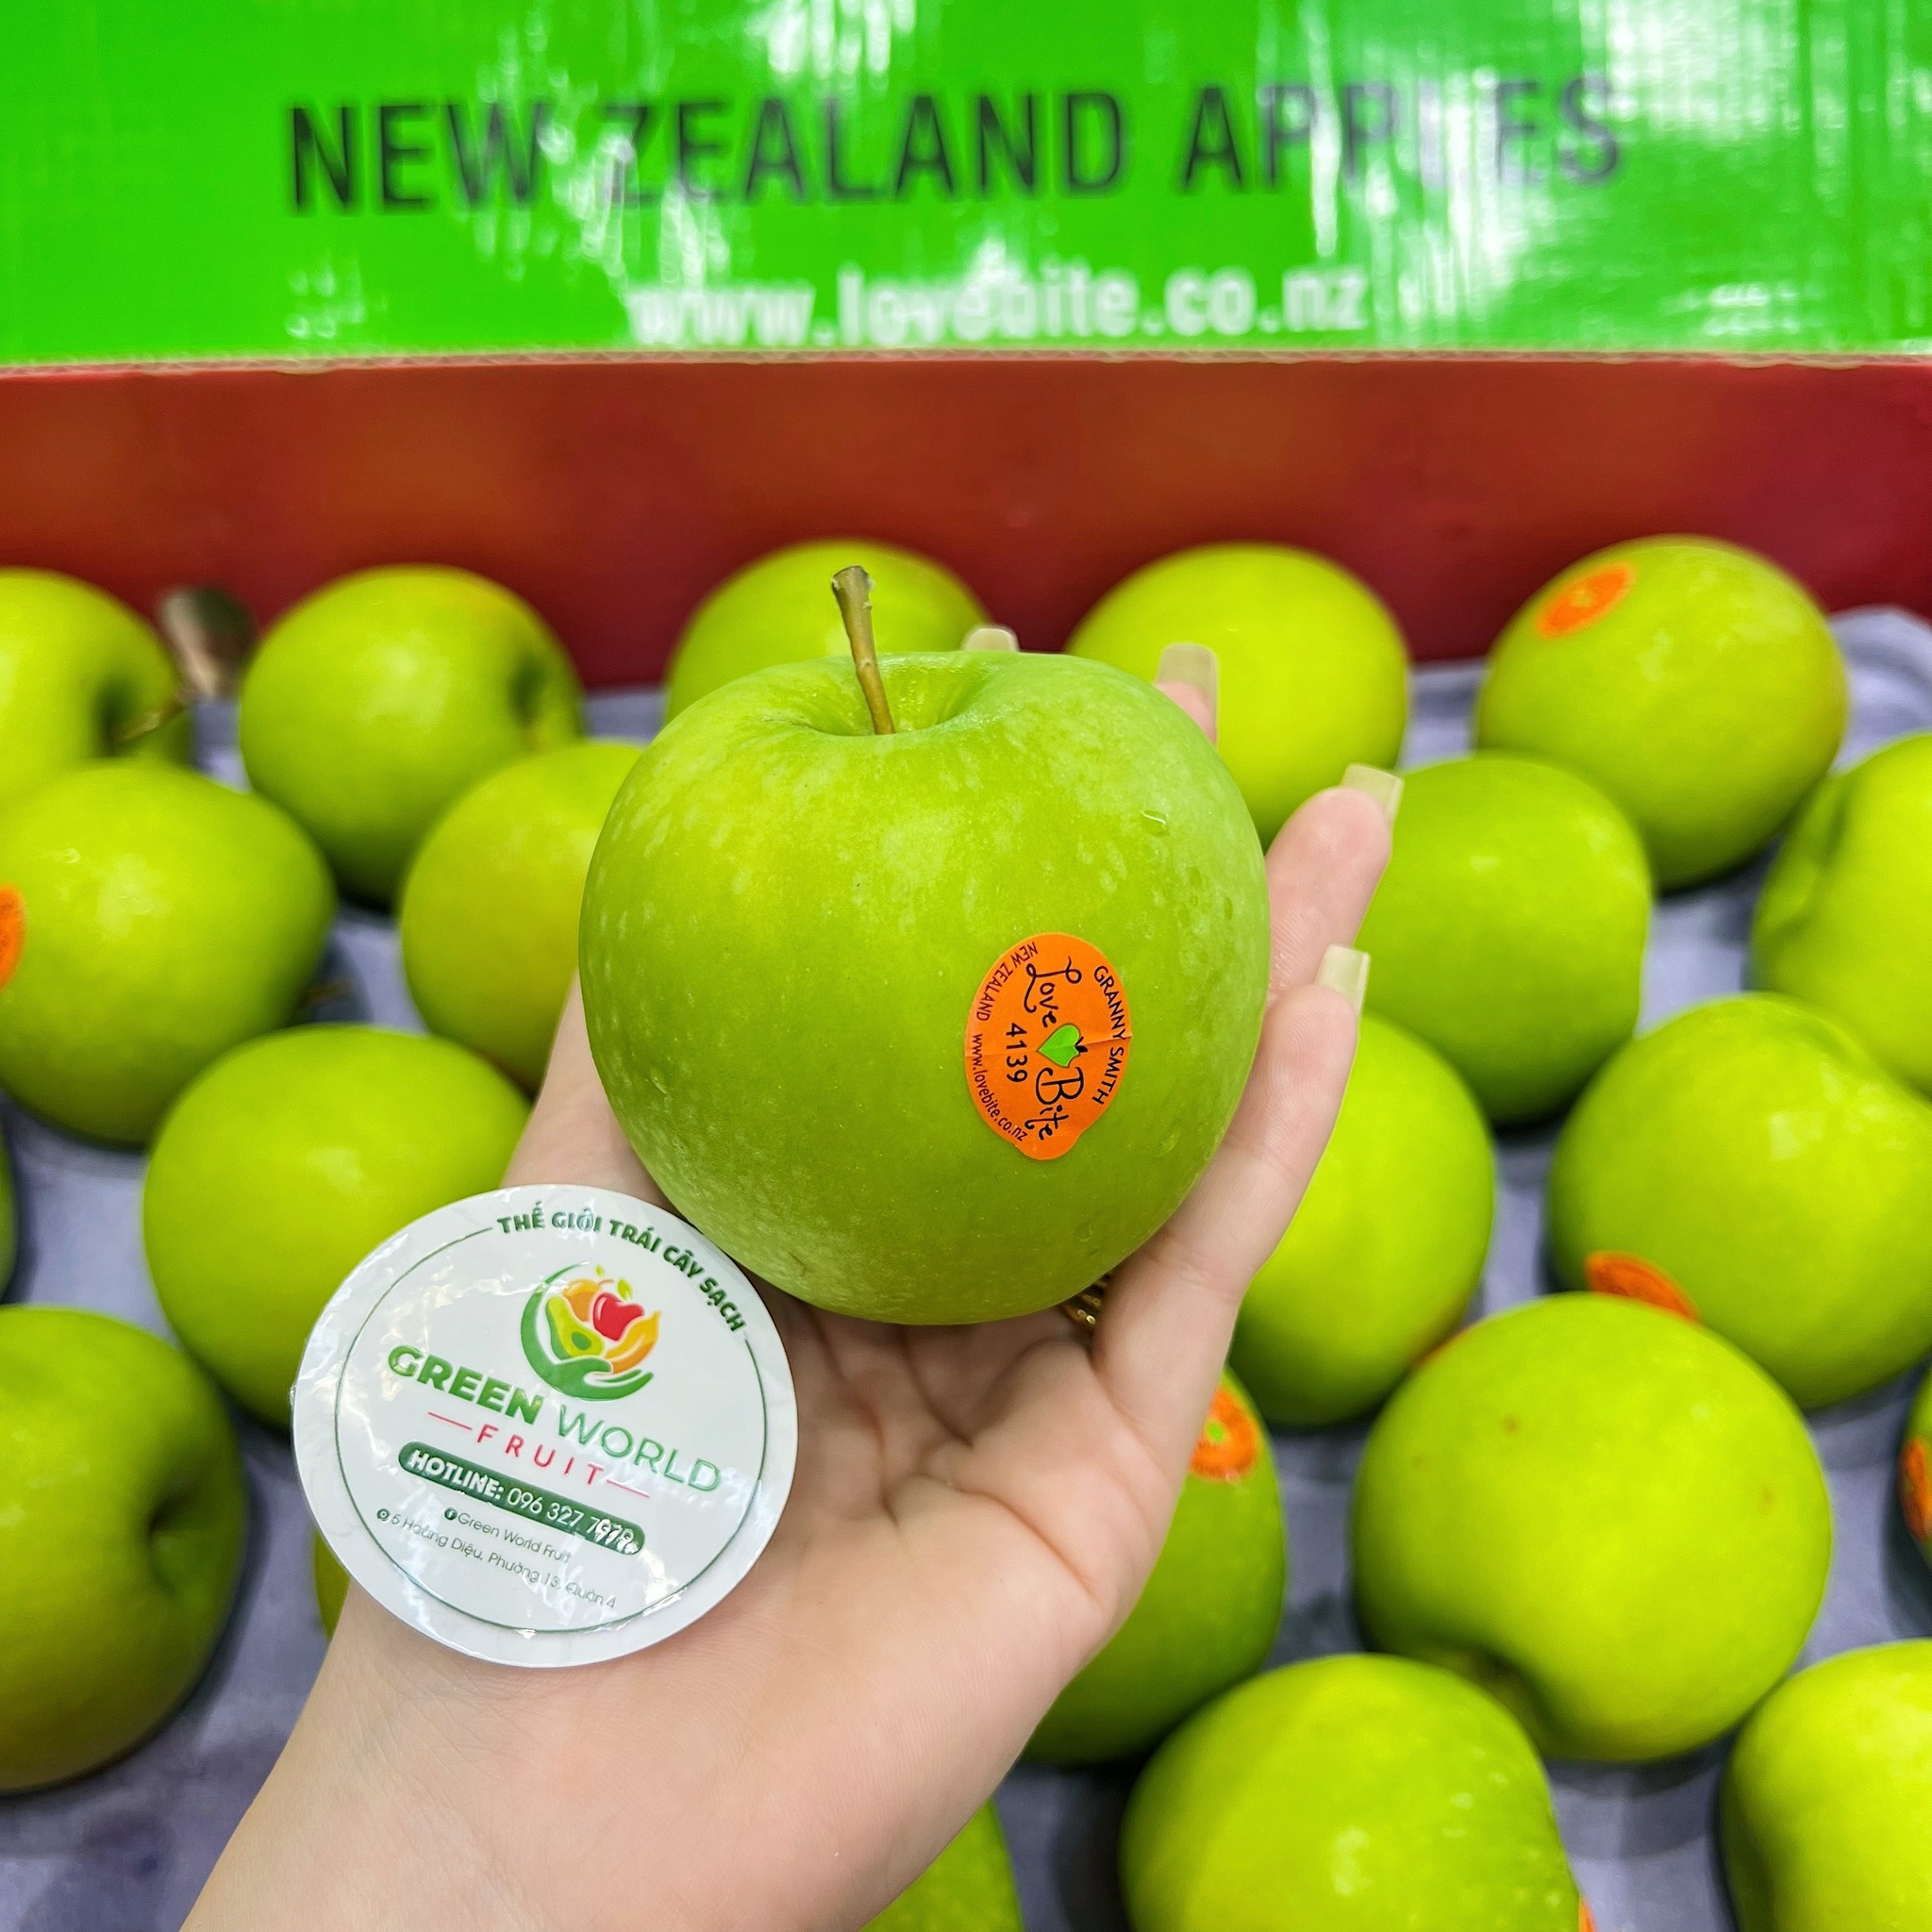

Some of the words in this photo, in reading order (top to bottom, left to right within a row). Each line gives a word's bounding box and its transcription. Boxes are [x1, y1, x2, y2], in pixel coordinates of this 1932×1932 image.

[289, 99, 547, 213] NEW
[601, 89, 1129, 206] ZEALAND
[626, 259, 1370, 344] www.lovebite.co.nz
[976, 961, 1013, 1022] ZEALAND
[1010, 941, 1039, 969] NEW
[1024, 956, 1082, 1028] Love
[1093, 965, 1127, 1041] GRANNY
[972, 1033, 1028, 1142] www.lovebite.co.nz
[1006, 1022, 1028, 1083] 4139
[1091, 1046, 1124, 1105] SMITH
[1024, 1066, 1084, 1141] Bite
[496, 1199, 546, 1235] THẾ
[609, 1218, 662, 1254] TRÁI
[662, 1244, 705, 1278] CÂY
[699, 1276, 747, 1332] SẠCH
[387, 1344, 544, 1425] GREEN
[557, 1404, 723, 1492] WORLD
[476, 1423, 604, 1485] FRUIT
[391, 1513, 402, 1525] 5
[408, 1449, 504, 1500] HOTLINE:
[507, 1488, 542, 1514] 096
[546, 1502, 584, 1527] 327
[458, 1512, 500, 1538] Green
[504, 1528, 542, 1553] World
[542, 1544, 571, 1563] Fruit
